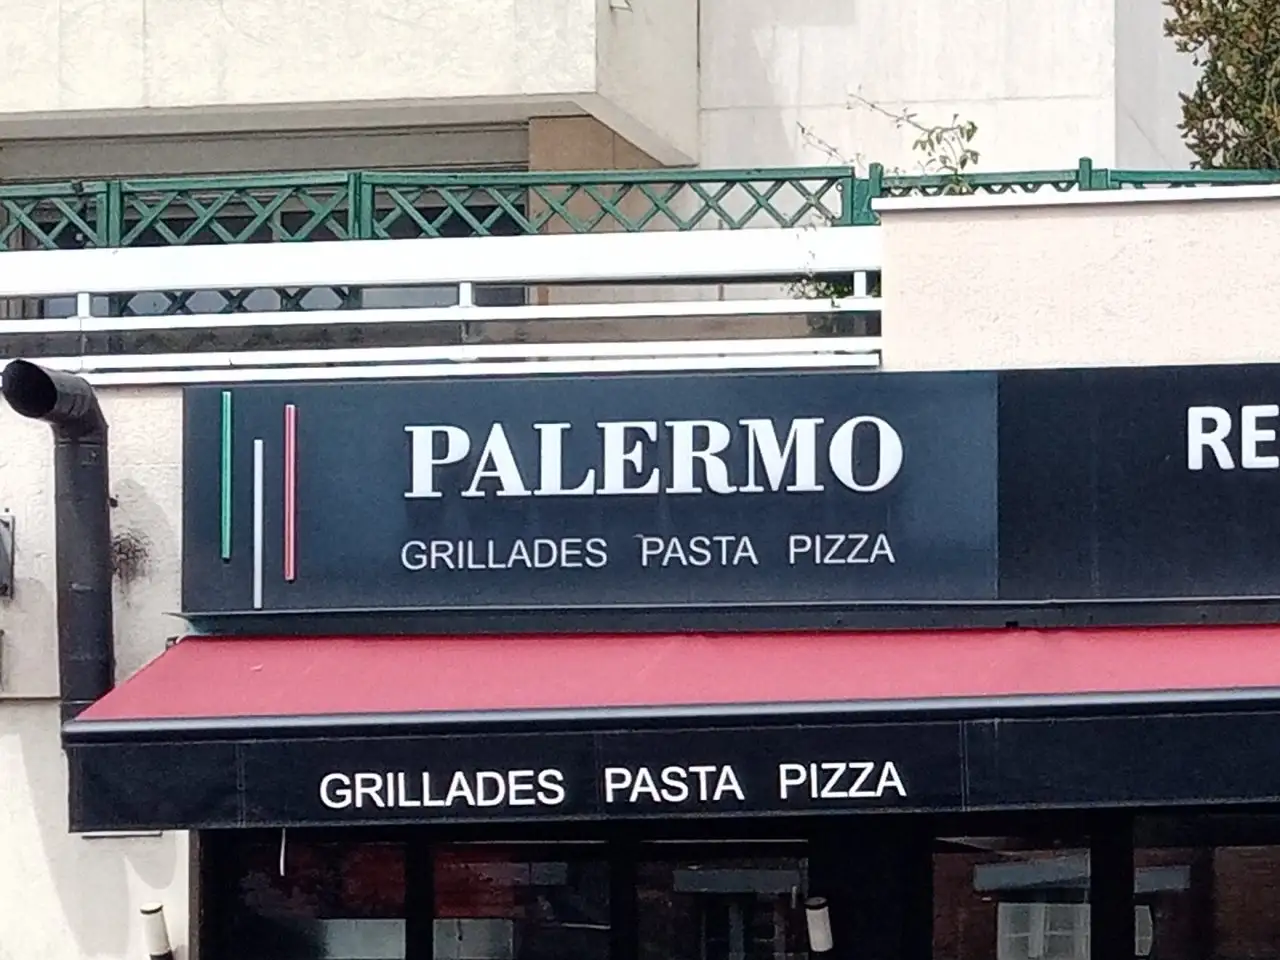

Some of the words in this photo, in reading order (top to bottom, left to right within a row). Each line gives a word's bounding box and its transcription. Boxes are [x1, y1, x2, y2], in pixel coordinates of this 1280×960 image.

[404, 415, 904, 498] PALERMO
[400, 537, 608, 570] GRILLADES
[640, 534, 759, 567] PASTA
[788, 532, 896, 565] PIZZA
[318, 767, 566, 810] GRILLADES
[603, 764, 746, 803] PASTA
[778, 761, 908, 800] PIZZA
